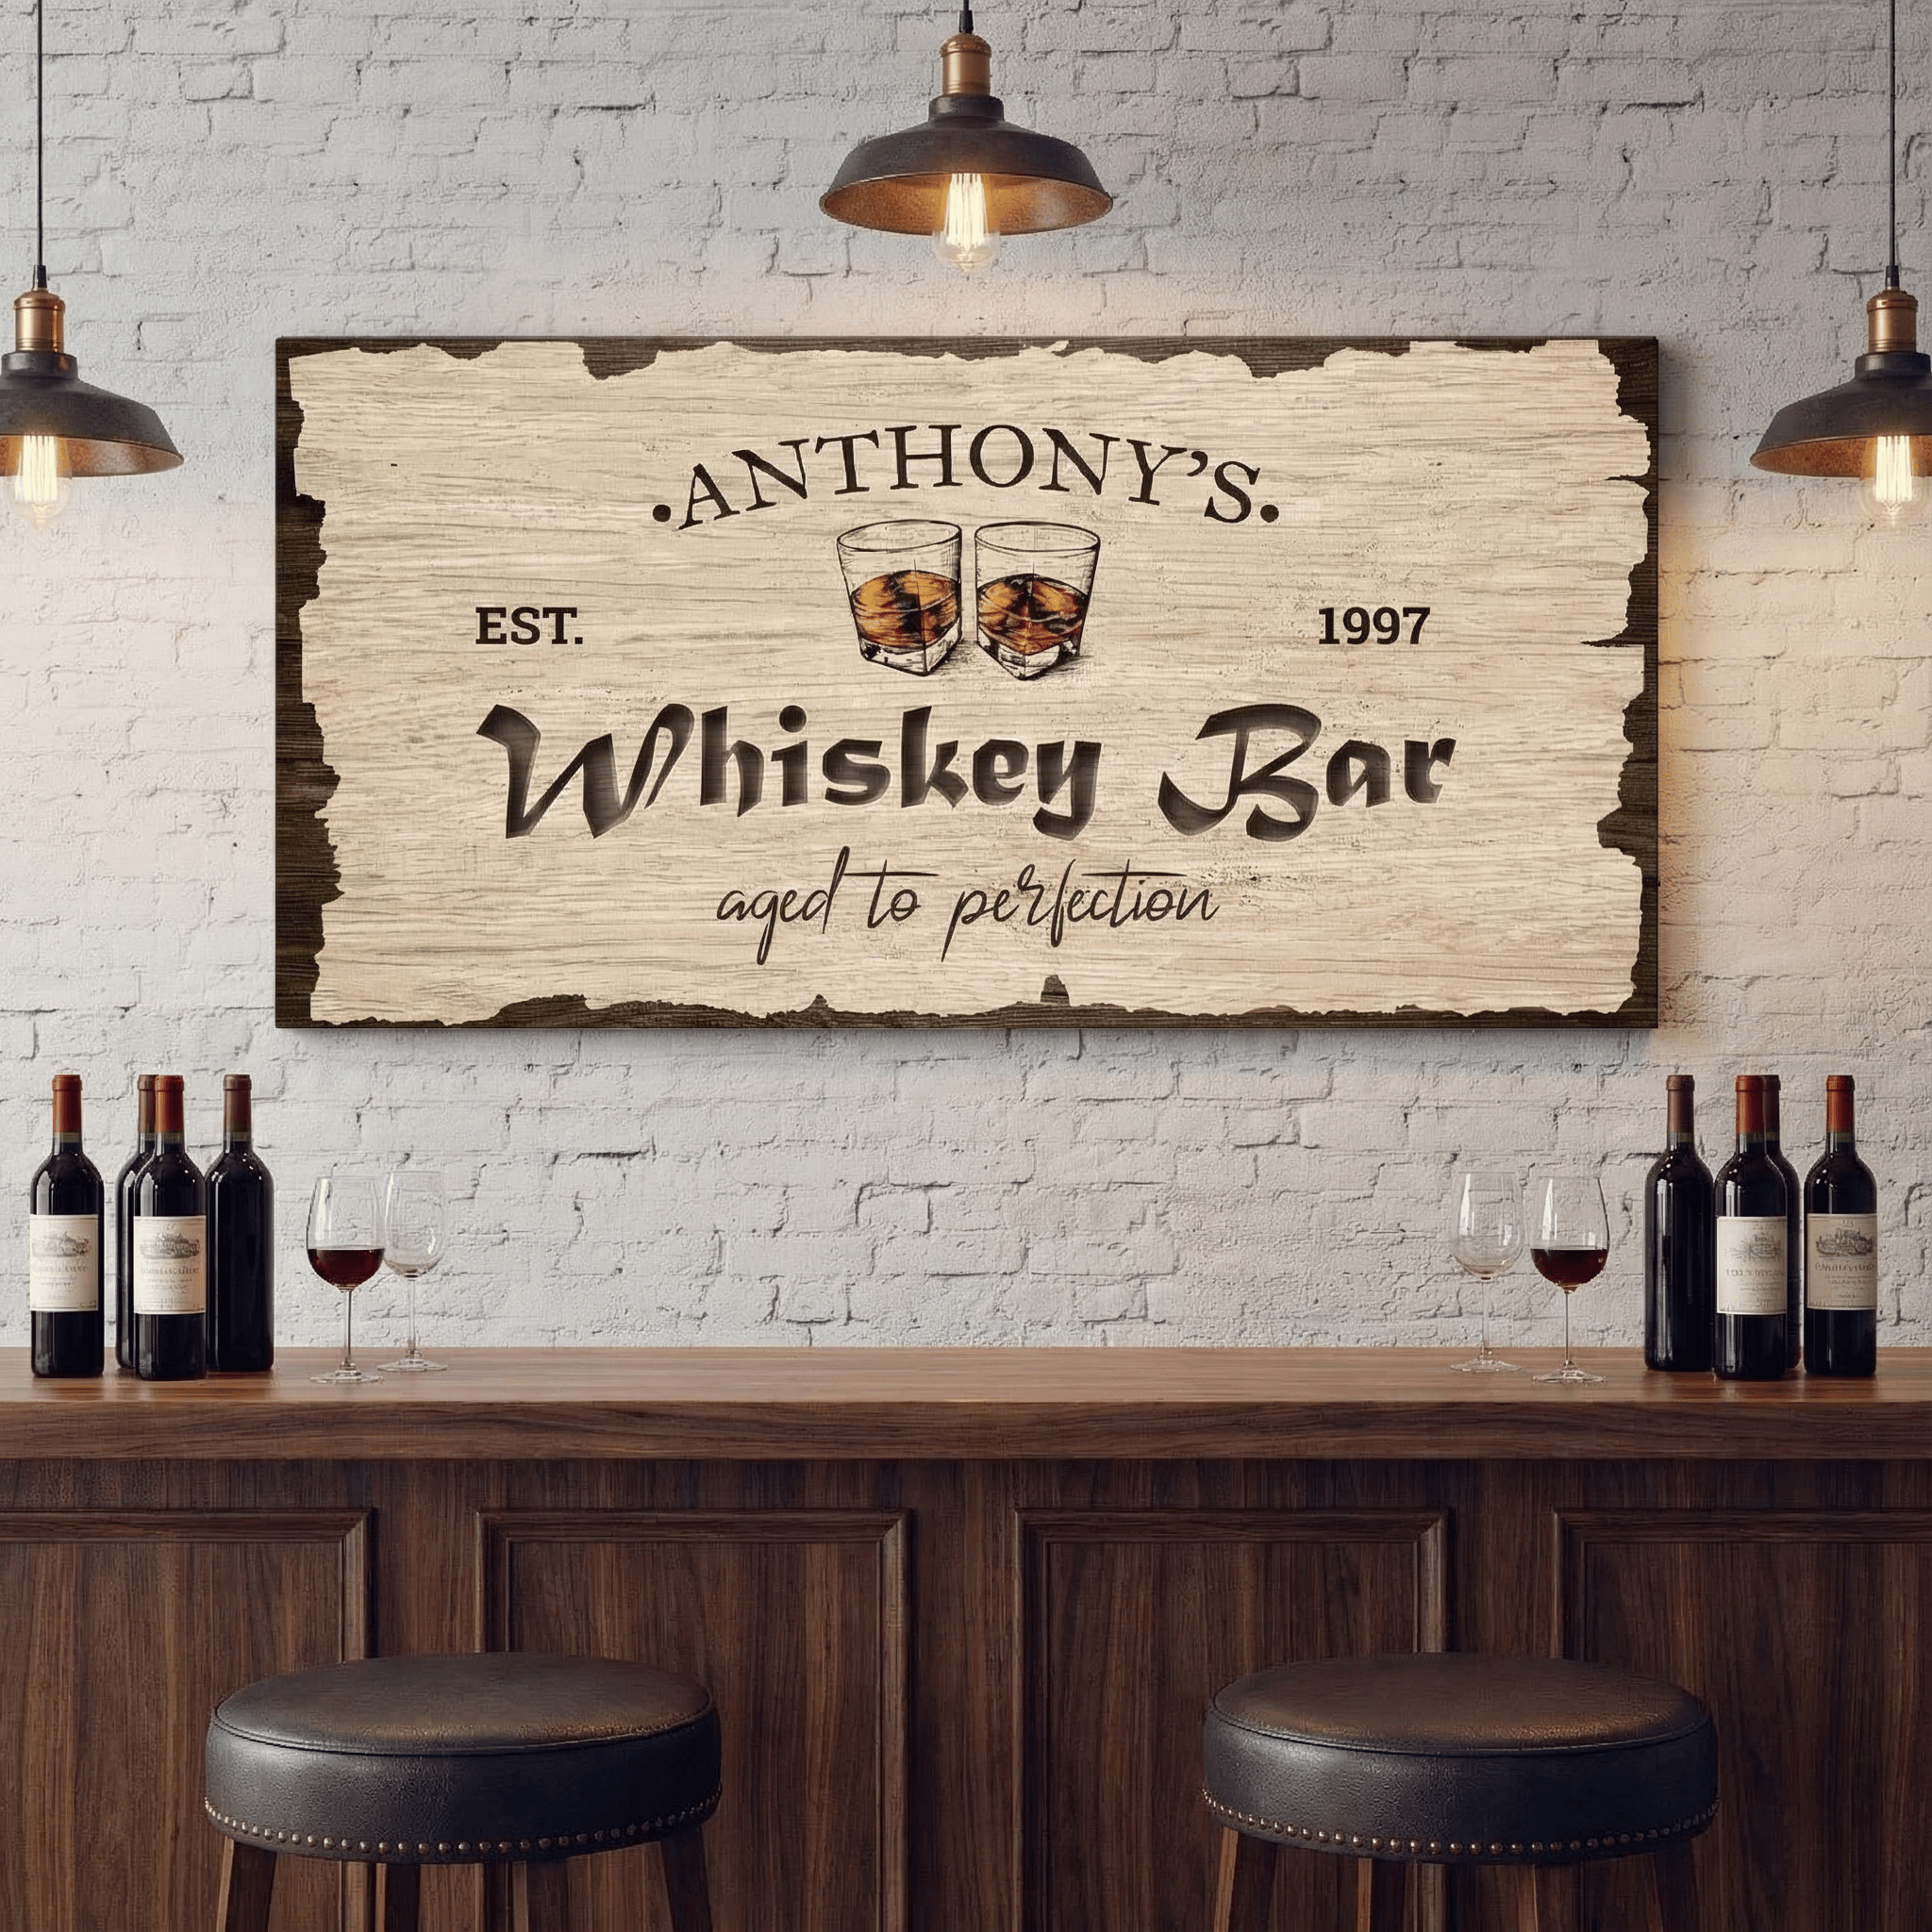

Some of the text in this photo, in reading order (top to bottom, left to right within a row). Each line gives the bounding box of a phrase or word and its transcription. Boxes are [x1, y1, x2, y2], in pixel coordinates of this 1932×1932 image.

[475, 606, 584, 645] EST.
[1318, 607, 1431, 645] 1997
[475, 703, 1457, 841] Whiskey Bar
[716, 845, 1220, 966] aged to perfection
